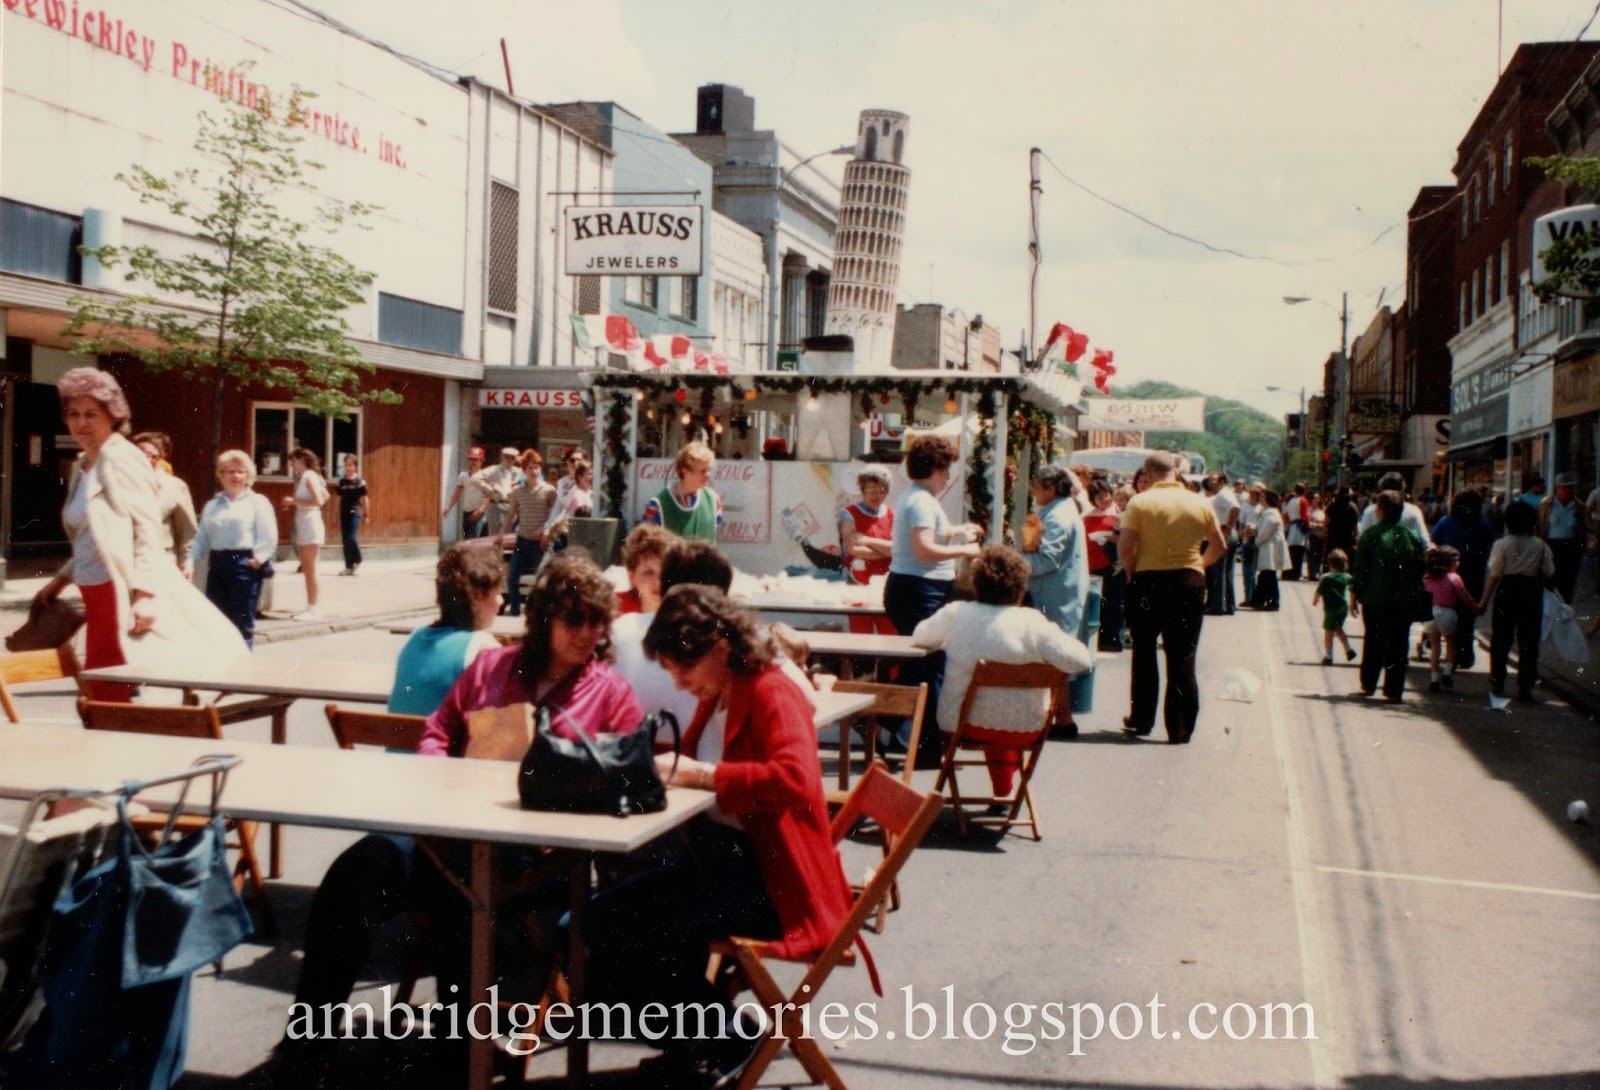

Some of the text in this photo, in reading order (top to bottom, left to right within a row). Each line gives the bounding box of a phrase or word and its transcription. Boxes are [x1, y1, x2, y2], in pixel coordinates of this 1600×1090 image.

[572, 211, 693, 241] KRAUSS
[586, 256, 679, 269] JEWELERS
[486, 391, 581, 407] KRAUSS
